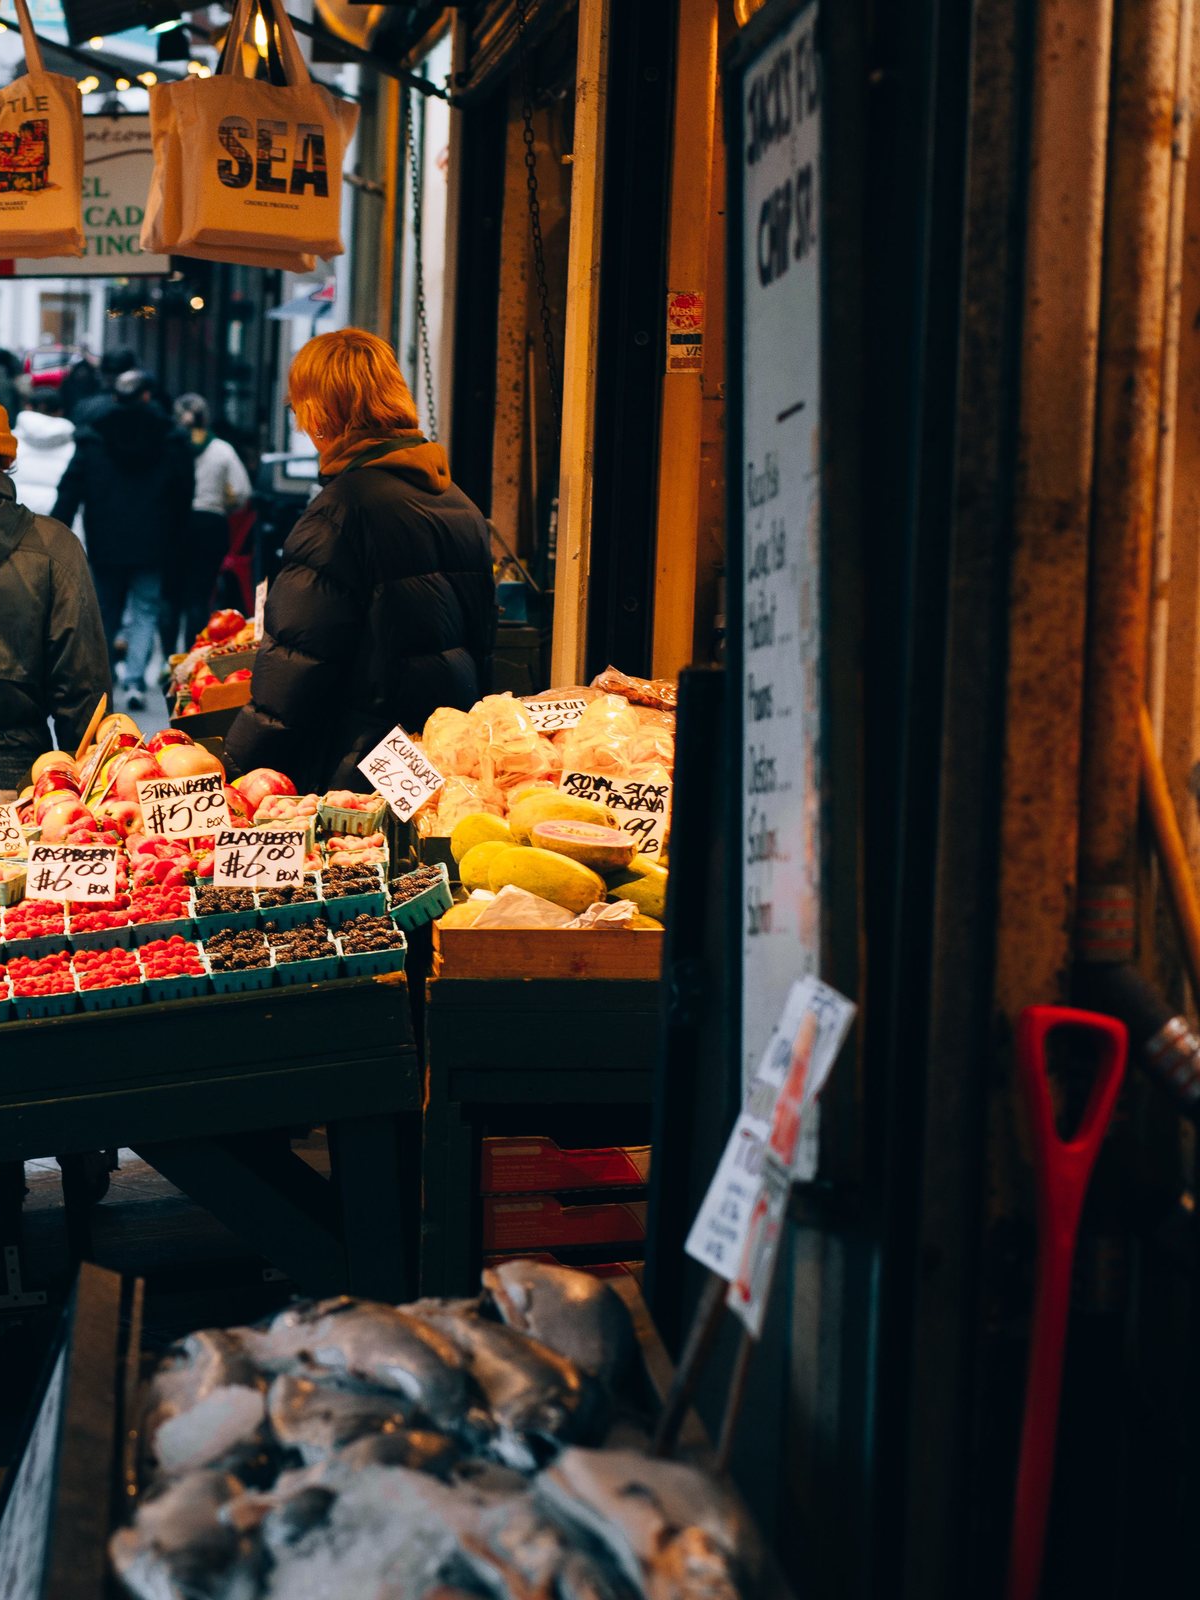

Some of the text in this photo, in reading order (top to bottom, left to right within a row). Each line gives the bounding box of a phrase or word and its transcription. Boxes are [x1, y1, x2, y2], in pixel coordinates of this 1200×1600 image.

[216, 115, 329, 198] SEA
[141, 774, 223, 802] STRAWBERRY
[562, 772, 670, 799] ROYAL STAR
[395, 796, 413, 813] BOX
[604, 792, 665, 814] PAPAYA
[206, 814, 230, 829] BOX
[215, 830, 305, 847] BLACKBERRY
[31, 846, 117, 862] RASPBERRY
[276, 869, 300, 883] BOX
[87, 883, 111, 896] BOX
